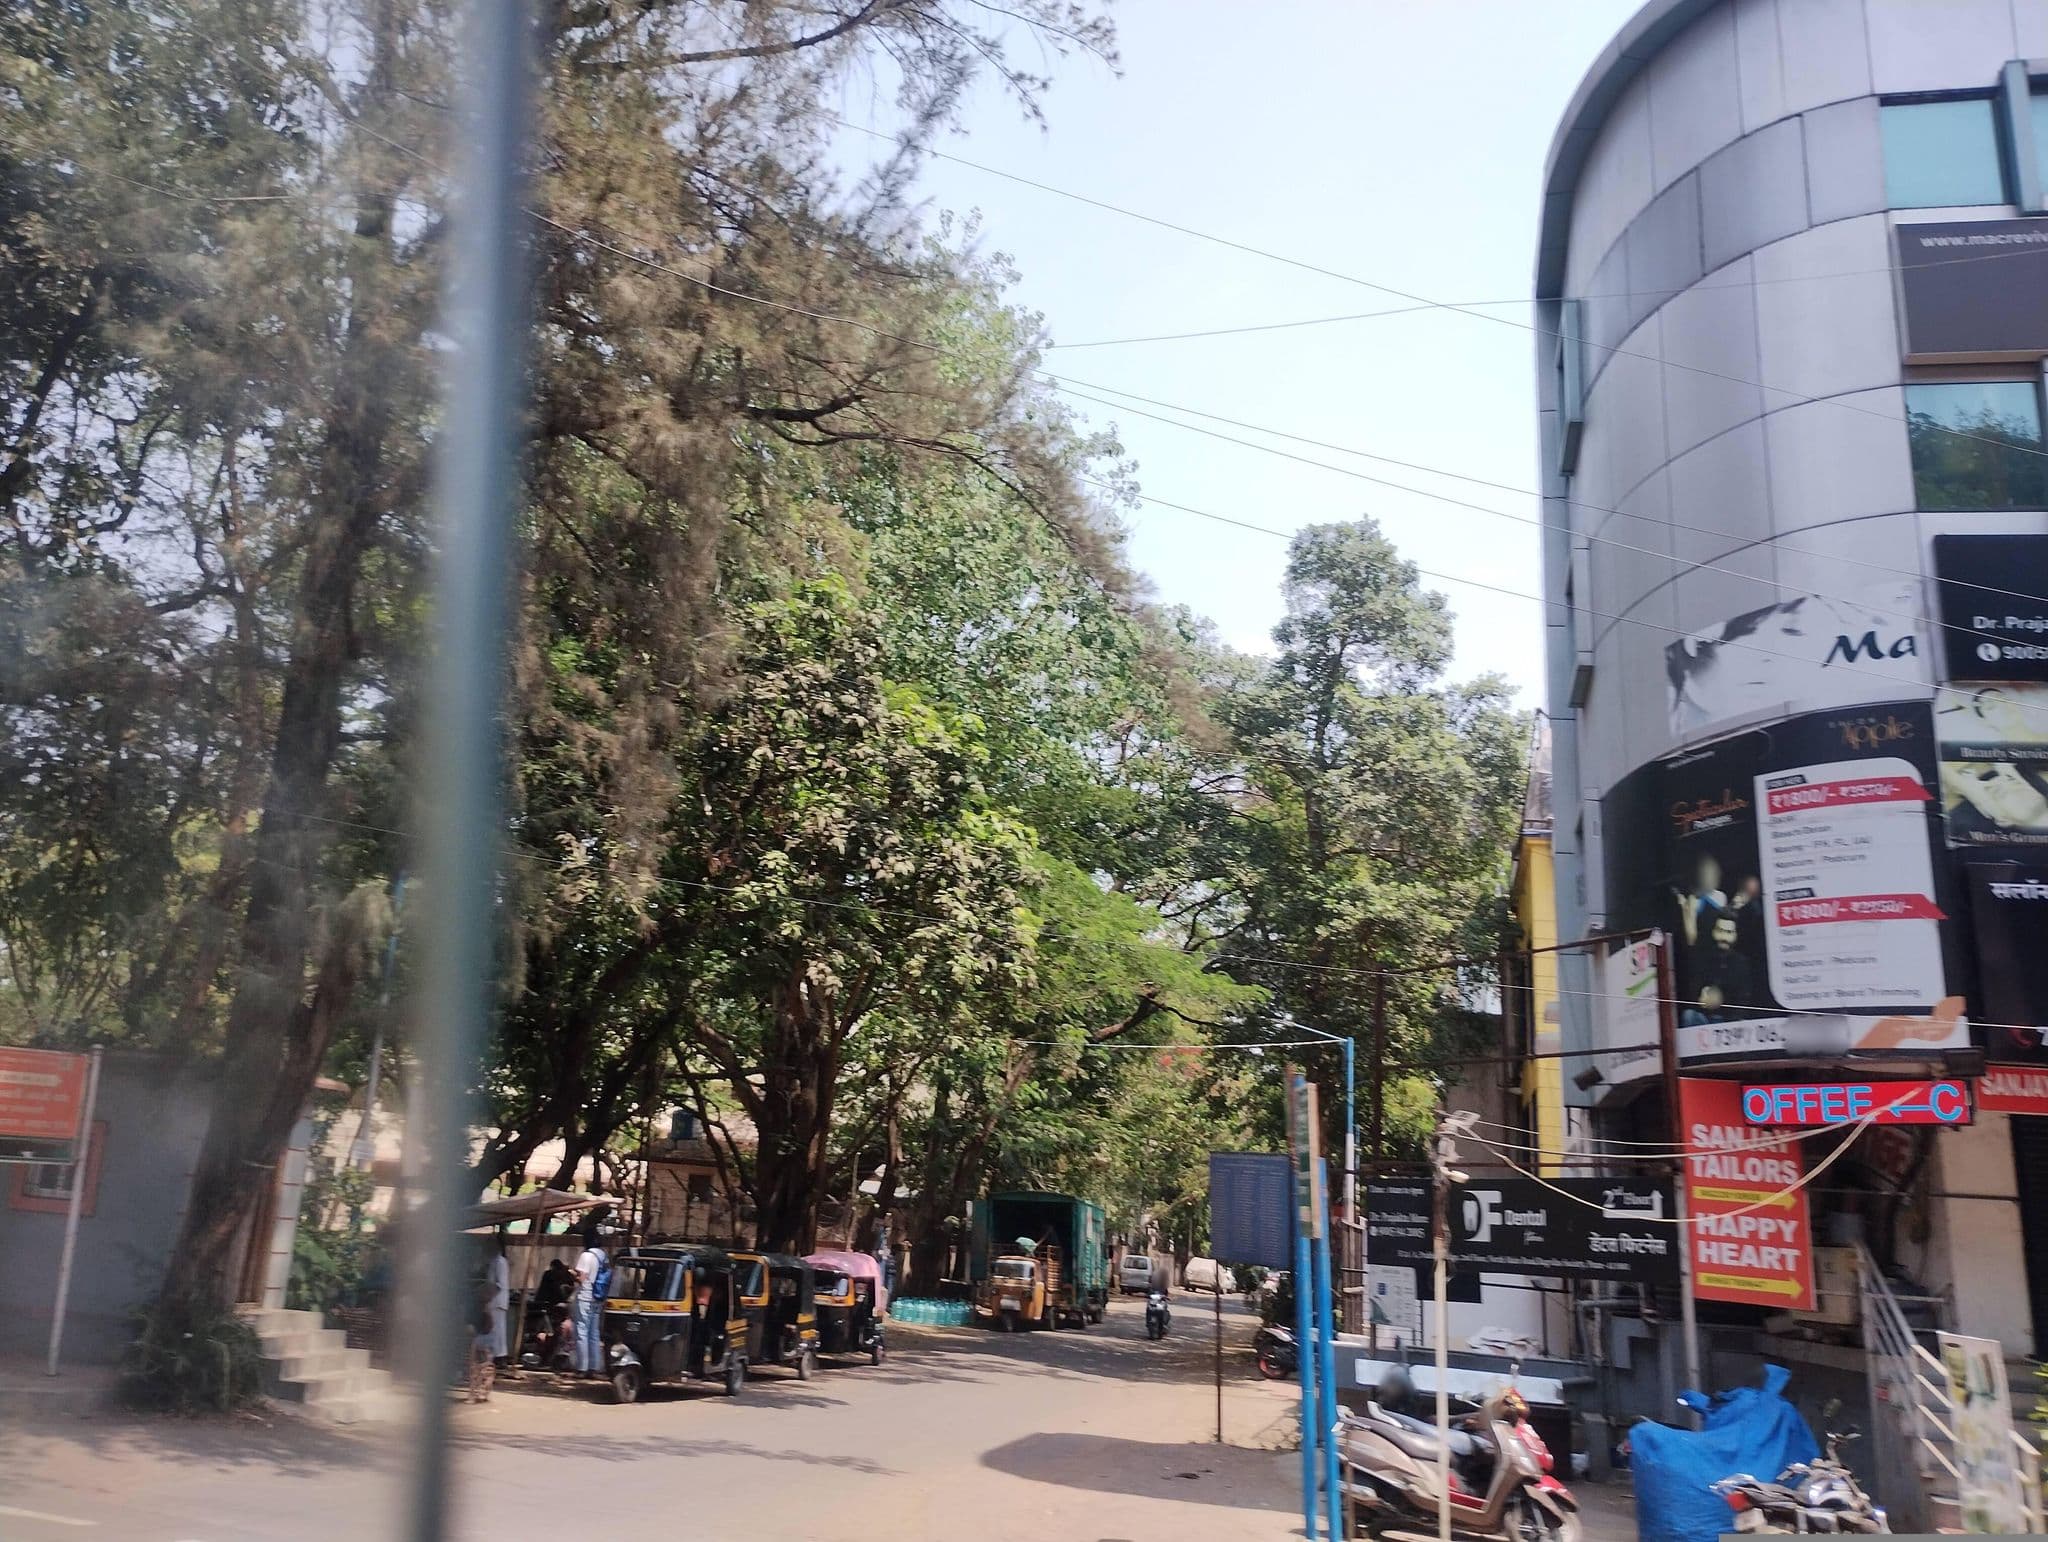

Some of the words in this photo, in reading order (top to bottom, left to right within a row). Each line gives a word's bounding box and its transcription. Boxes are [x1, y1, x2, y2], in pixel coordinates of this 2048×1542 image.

[1743, 1085, 1873, 1123] OFFEE
[1929, 1083, 1964, 1121] C
[1692, 1155, 1799, 1185] TAILORS
[1696, 1211, 1799, 1243] HAPPY
[1697, 1239, 1801, 1271] HEART
